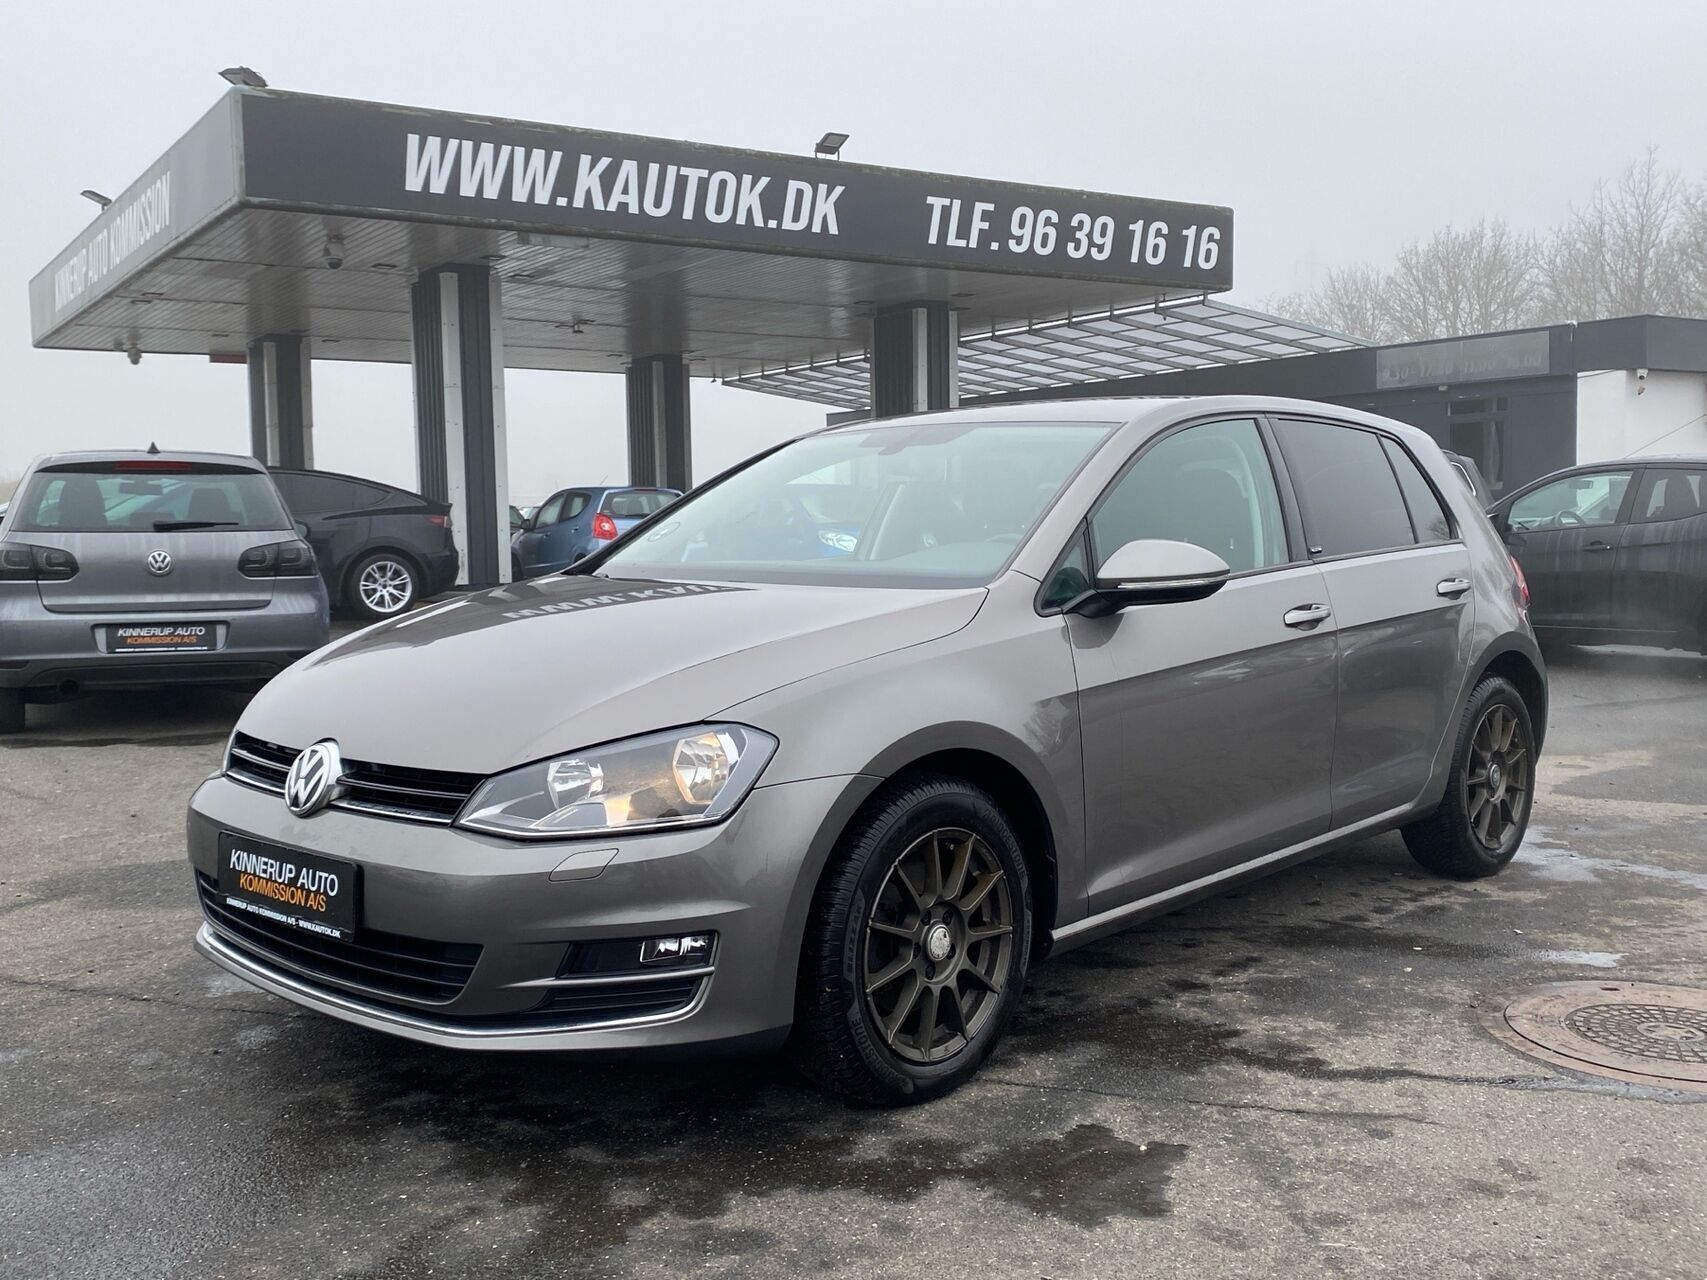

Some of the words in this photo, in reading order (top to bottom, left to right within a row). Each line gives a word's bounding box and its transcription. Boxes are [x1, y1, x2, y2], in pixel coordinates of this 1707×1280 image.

[404, 133, 846, 236] WWW.KAUTOK.DK
[110, 171, 170, 270] KOMMISSION
[926, 196, 1000, 251] TLF.
[1008, 206, 1059, 256] 96
[1067, 212, 1115, 261] 39
[1128, 219, 1169, 265] 16
[1182, 225, 1220, 270] 16
[117, 627, 174, 637] KINNERUP
[175, 626, 205, 636] AUTO
[230, 849, 295, 884] KINNERUP
[297, 867, 338, 897] AUTO
[239, 874, 306, 906] KOMMISSION
[307, 894, 327, 912] A/S
